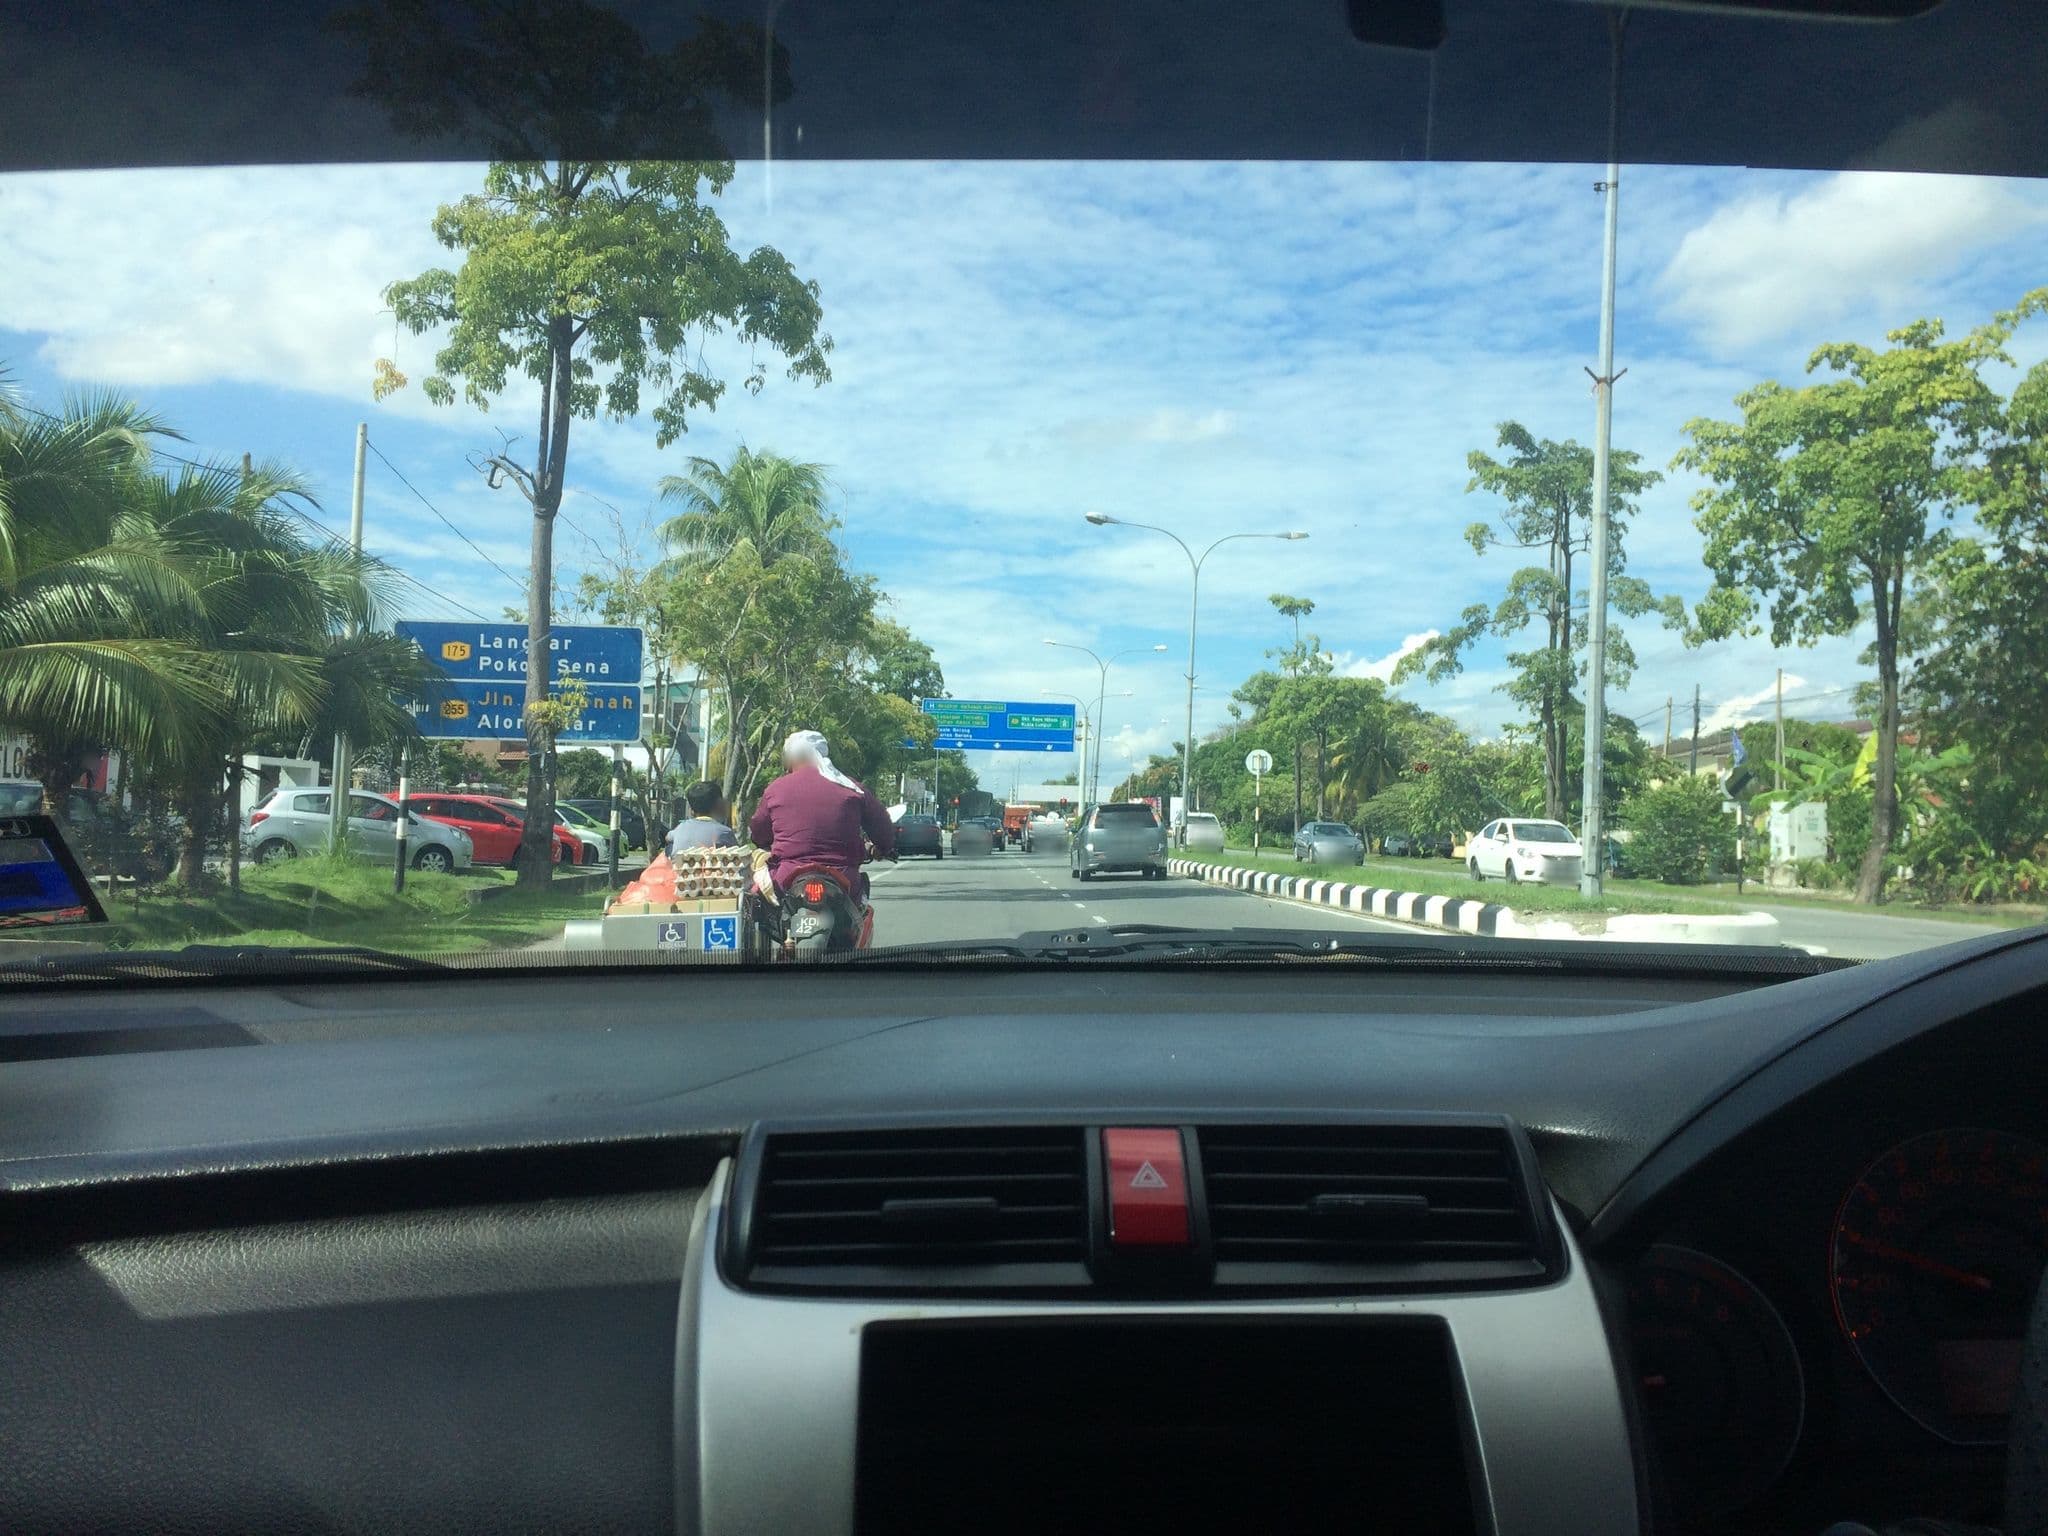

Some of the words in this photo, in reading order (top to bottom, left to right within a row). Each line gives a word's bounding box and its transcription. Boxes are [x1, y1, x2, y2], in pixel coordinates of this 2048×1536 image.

[447, 645, 466, 657] 175
[557, 658, 610, 674] Sena
[443, 703, 465, 715] 255
